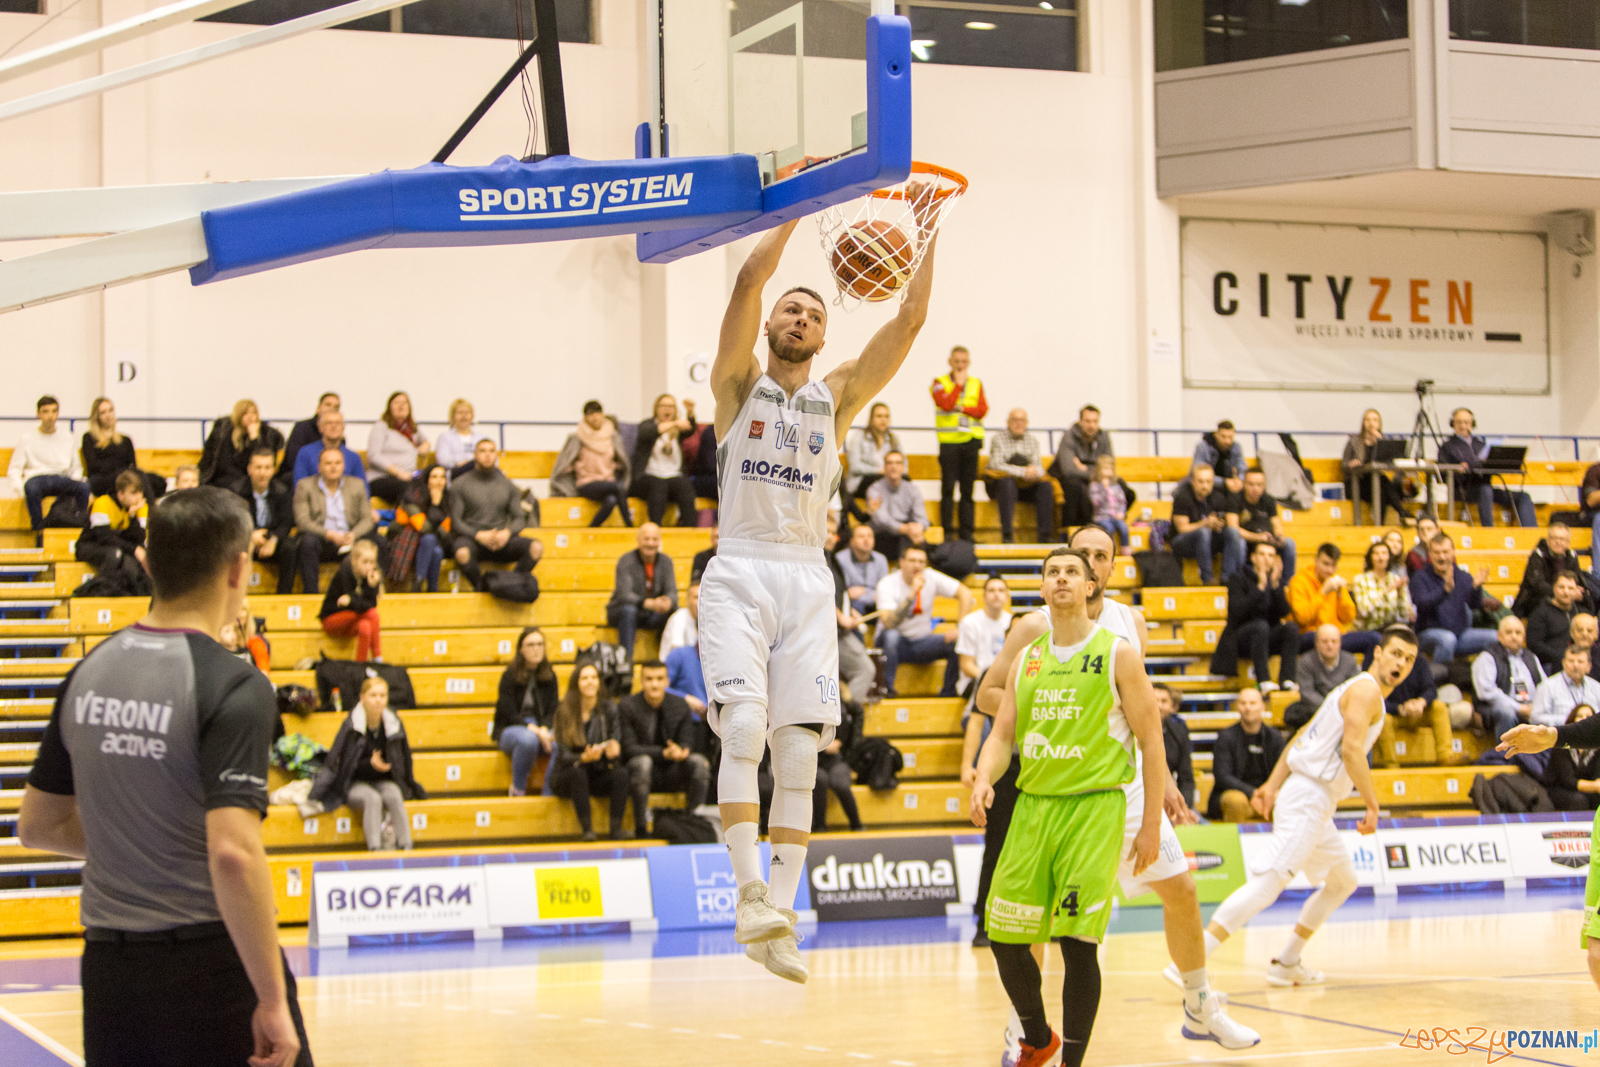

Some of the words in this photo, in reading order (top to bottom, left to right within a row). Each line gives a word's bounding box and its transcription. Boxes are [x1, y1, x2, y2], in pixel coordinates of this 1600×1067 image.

[1212, 271, 1473, 325] CITYZEN
[1371, 326, 1403, 340] KLUB
[1409, 328, 1474, 342] SPORTOWY
[118, 361, 136, 383] D
[689, 362, 706, 383] C
[775, 421, 800, 453] 14
[741, 459, 814, 486] BIOFARM
[759, 476, 795, 489] PRODUCENT
[1080, 655, 1104, 674] 14
[715, 677, 745, 688] macron
[1034, 689, 1077, 704] ZNICZ
[74, 690, 173, 735] VERONI
[1031, 706, 1084, 722] BASKET
[101, 731, 168, 760] active
[1417, 841, 1507, 866] NICKEL
[811, 853, 955, 891] drukma
[327, 883, 472, 911] BIOFARM
[993, 900, 1017, 915] LOGO
